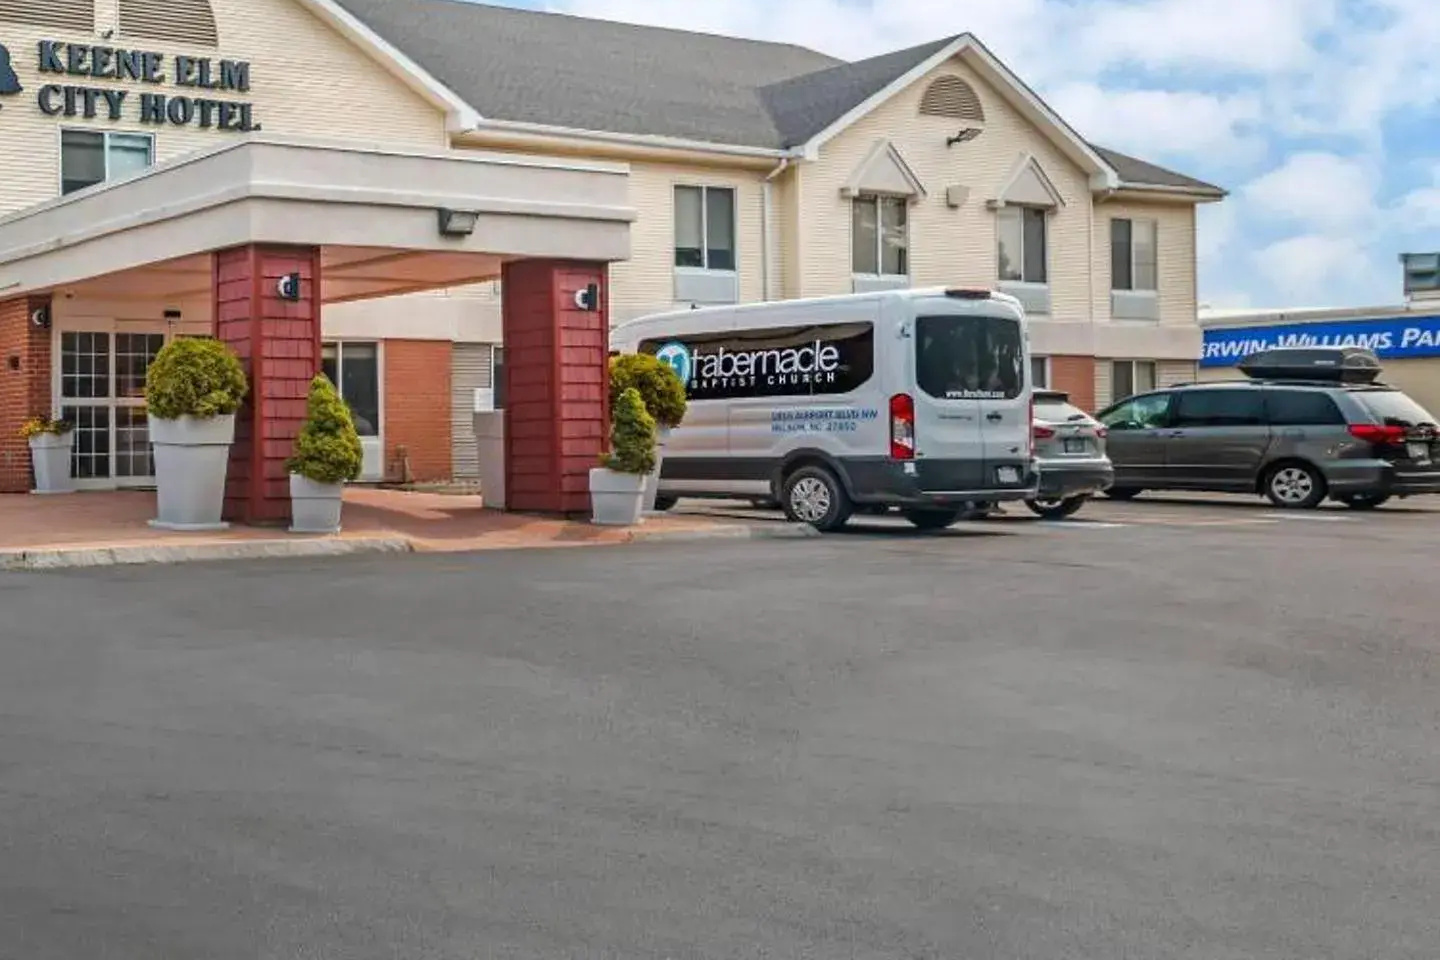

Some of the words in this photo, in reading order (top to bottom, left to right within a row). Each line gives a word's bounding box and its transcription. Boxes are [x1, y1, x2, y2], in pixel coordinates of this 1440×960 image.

[38, 40, 165, 83] KEENE
[176, 55, 250, 91] ELM
[38, 84, 128, 119] CITY
[140, 93, 261, 131] HOTEL
[691, 340, 839, 378] tabernacle
[691, 375, 756, 389] BAPTIST
[767, 372, 835, 386] CHURCH
